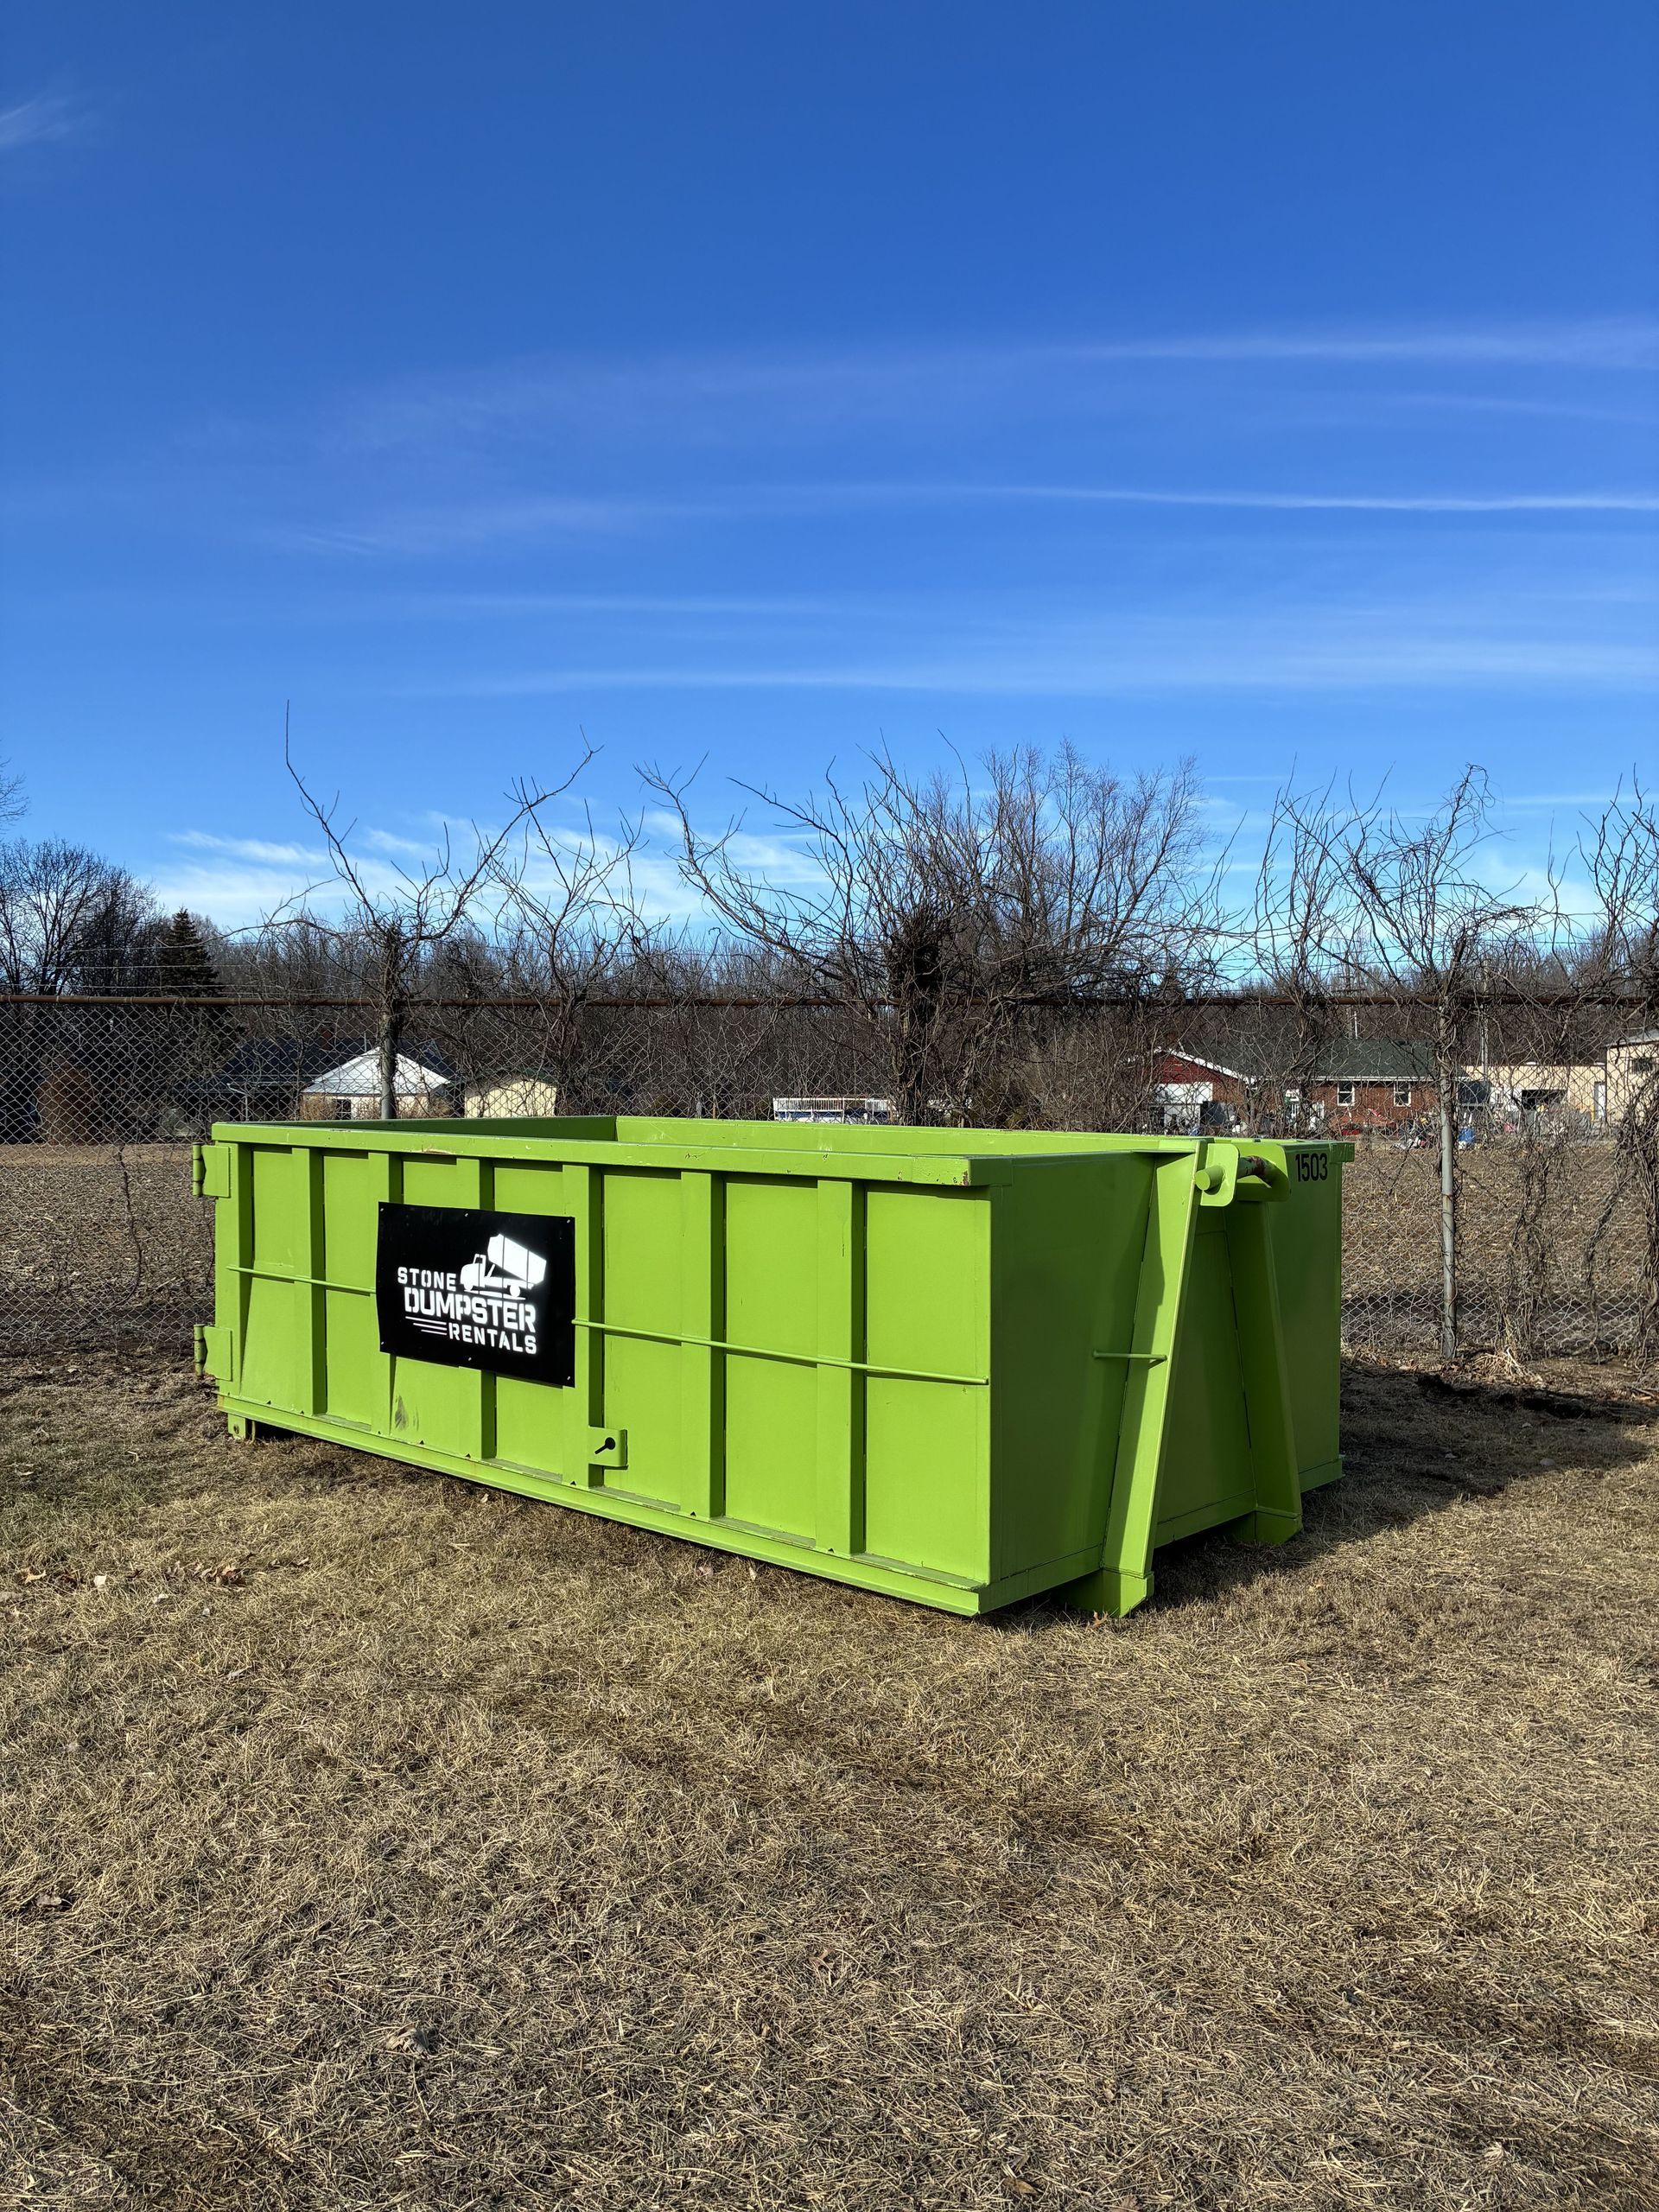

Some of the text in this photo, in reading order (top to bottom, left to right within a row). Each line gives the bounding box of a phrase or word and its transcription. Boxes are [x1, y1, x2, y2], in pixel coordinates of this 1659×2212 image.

[1295, 1153, 1328, 1182] 1503
[397, 1267, 456, 1291] STONE
[404, 1287, 536, 1333] DUMPSTER
[448, 1322, 537, 1355] RENTALS
